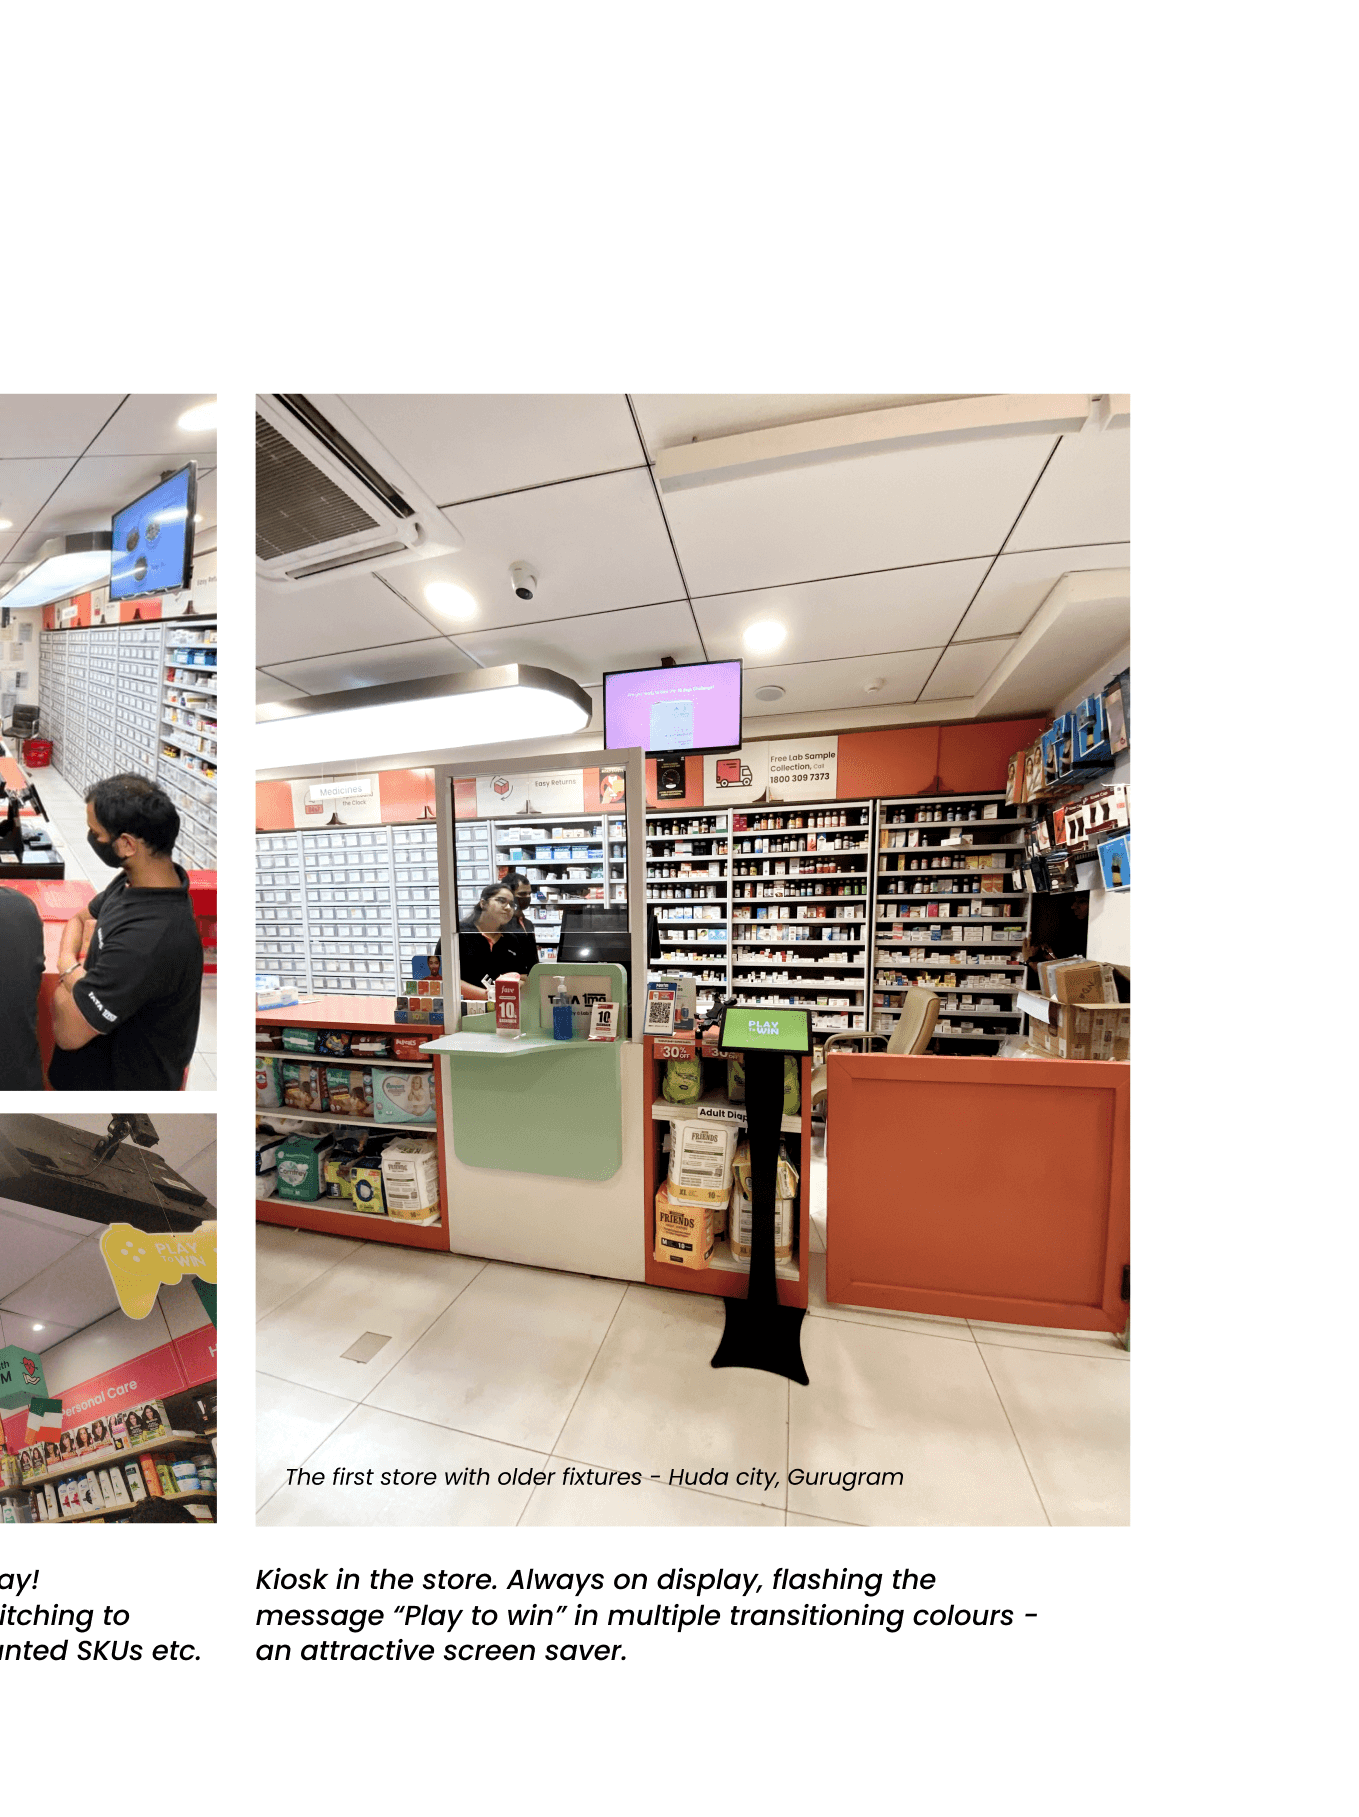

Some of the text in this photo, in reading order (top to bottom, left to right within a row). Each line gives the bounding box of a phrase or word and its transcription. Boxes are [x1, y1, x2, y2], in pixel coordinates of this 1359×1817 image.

[770, 755, 787, 763] Free
[804, 751, 836, 761] Sample
[770, 763, 812, 772] Collection,
[534, 778, 577, 788] Easy Returns
[770, 772, 830, 784] 1800 309 7373
[319, 785, 363, 797] Medicines
[748, 1020, 779, 1029] PLAY
[756, 1027, 780, 1035] WIN
[699, 1108, 748, 1123] Adult Diap
[691, 1132, 719, 1143] FRIENDS
[659, 1212, 695, 1229] FRIENDS
[154, 1242, 198, 1255] PLAY
[174, 1255, 207, 1267] WIN
[61, 1380, 138, 1417] Personal Care
